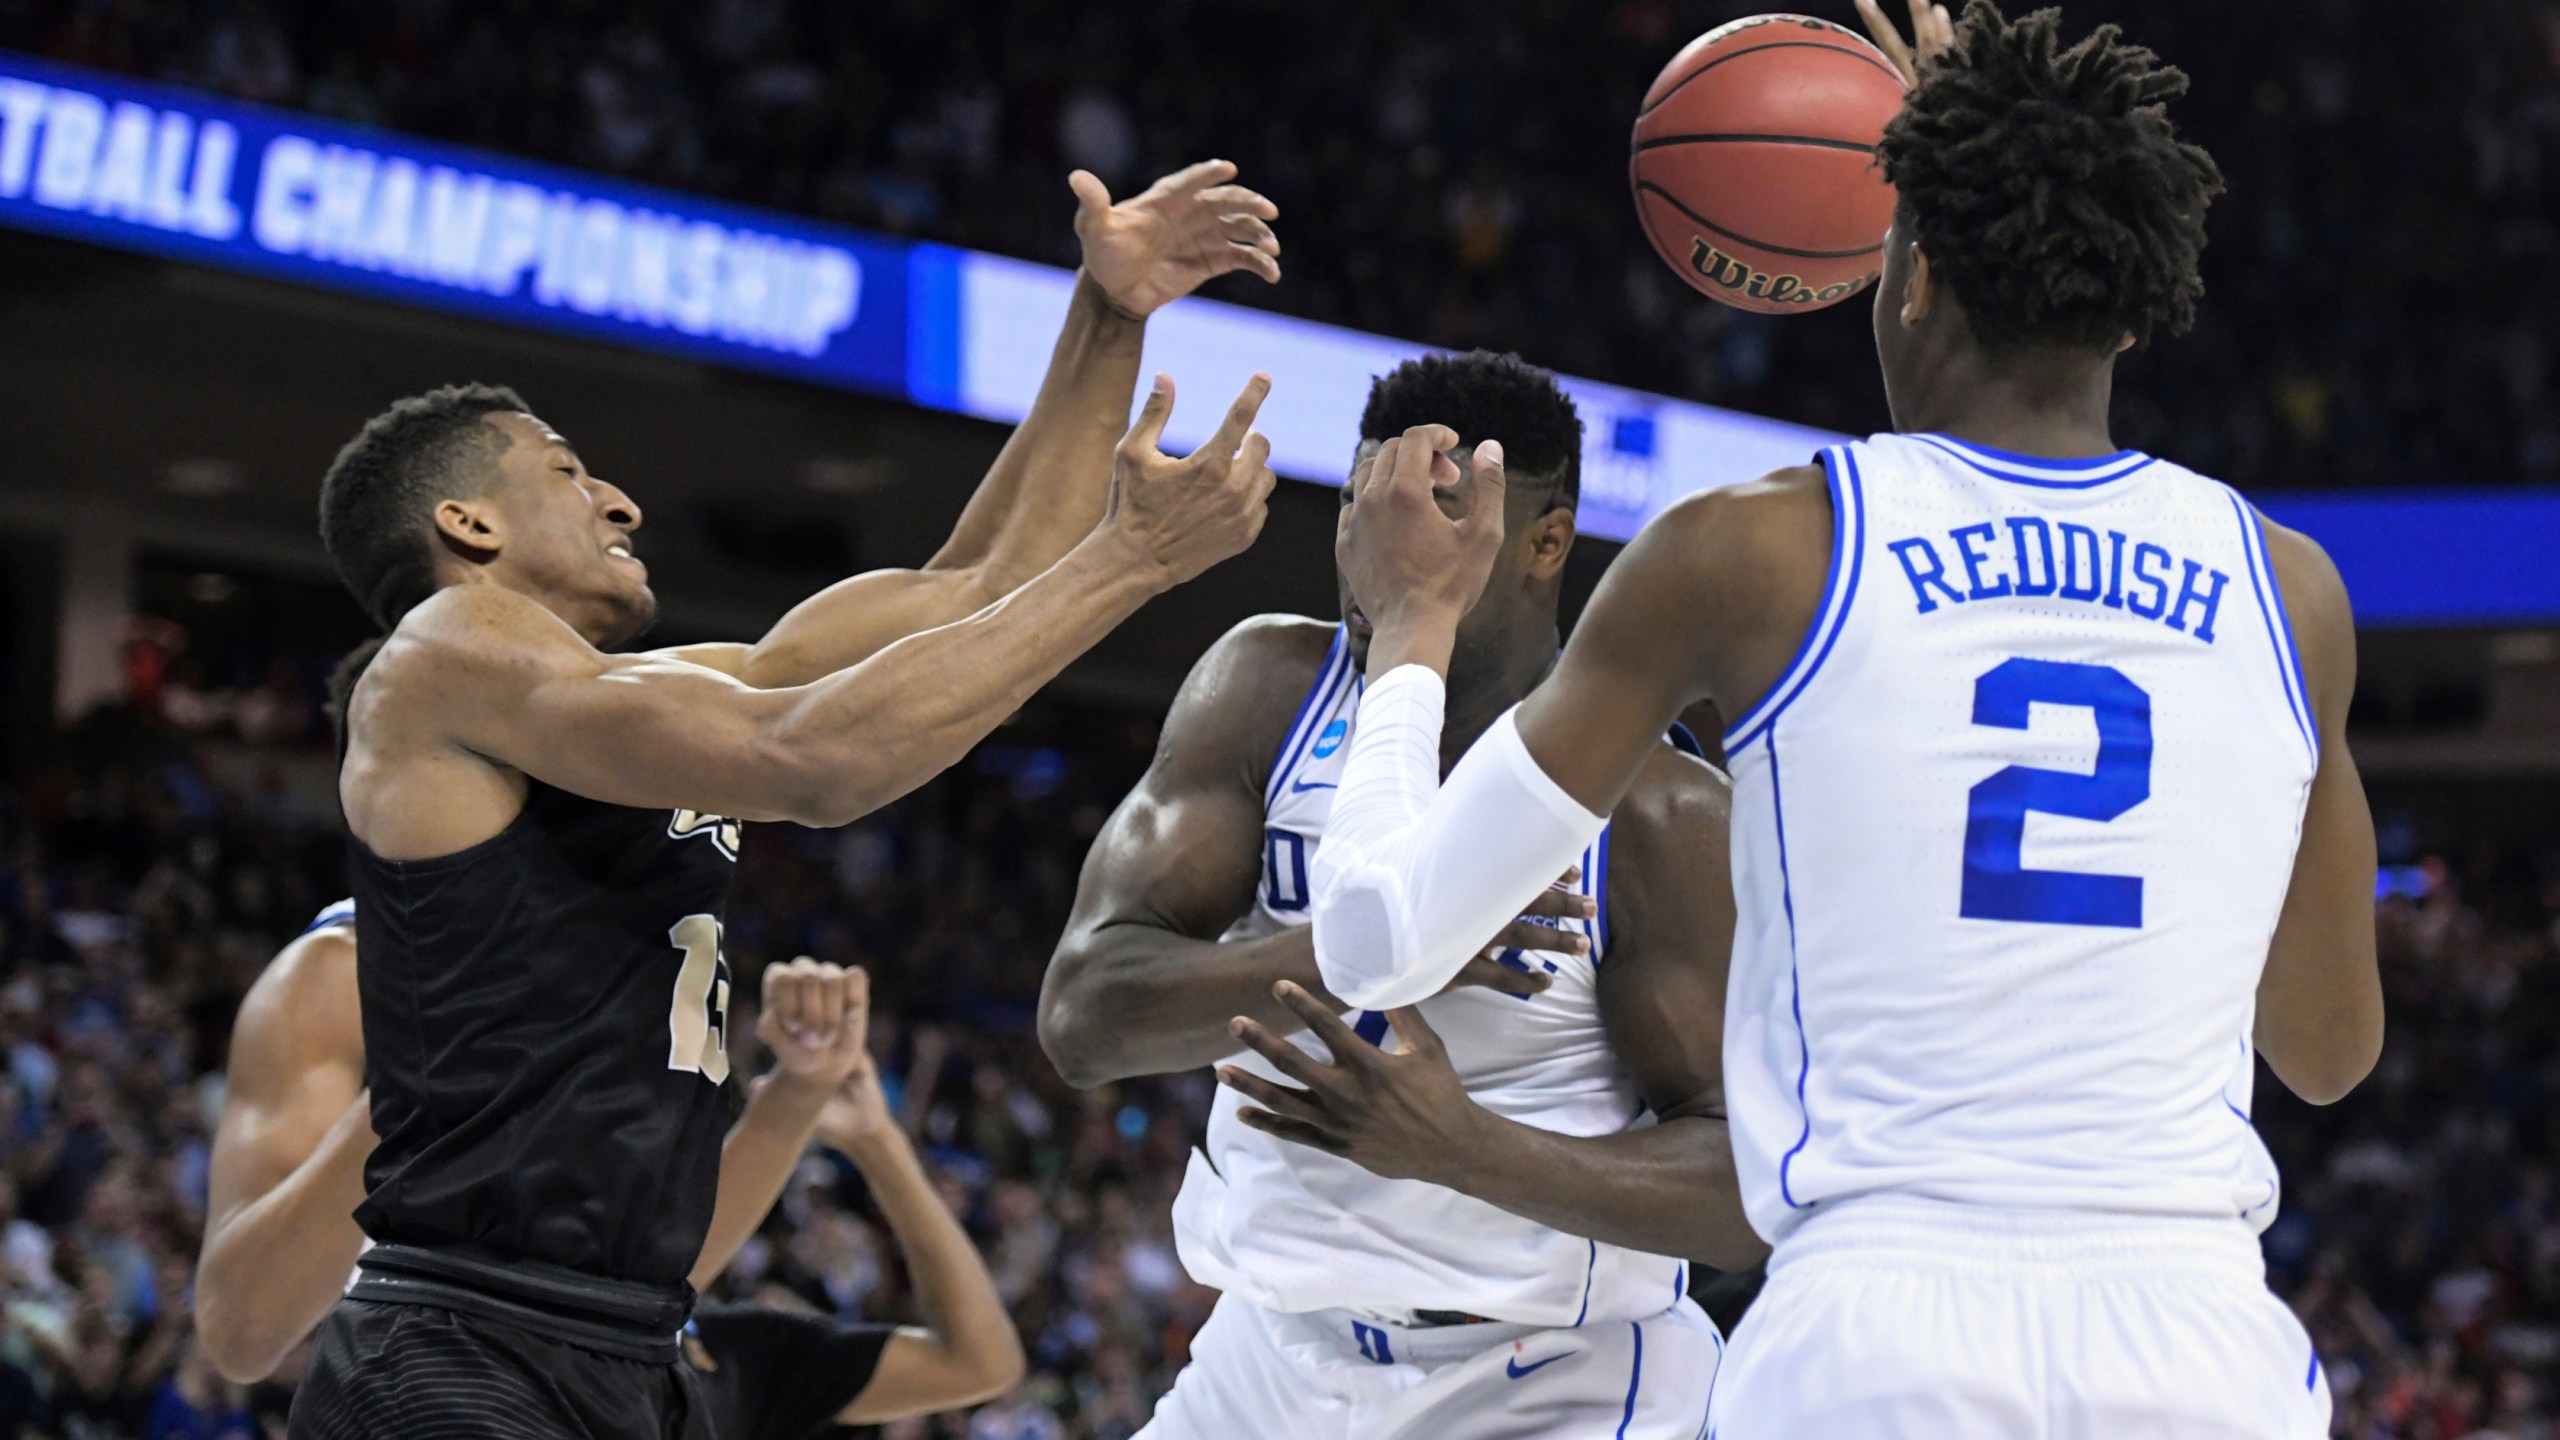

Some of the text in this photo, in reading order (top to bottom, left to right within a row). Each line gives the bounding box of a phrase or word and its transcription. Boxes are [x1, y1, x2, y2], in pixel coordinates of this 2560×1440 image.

[250, 133, 864, 358] CHAMPIONSHIP
[1887, 516, 2230, 645] REDDISH
[1959, 655, 2154, 929] 2
